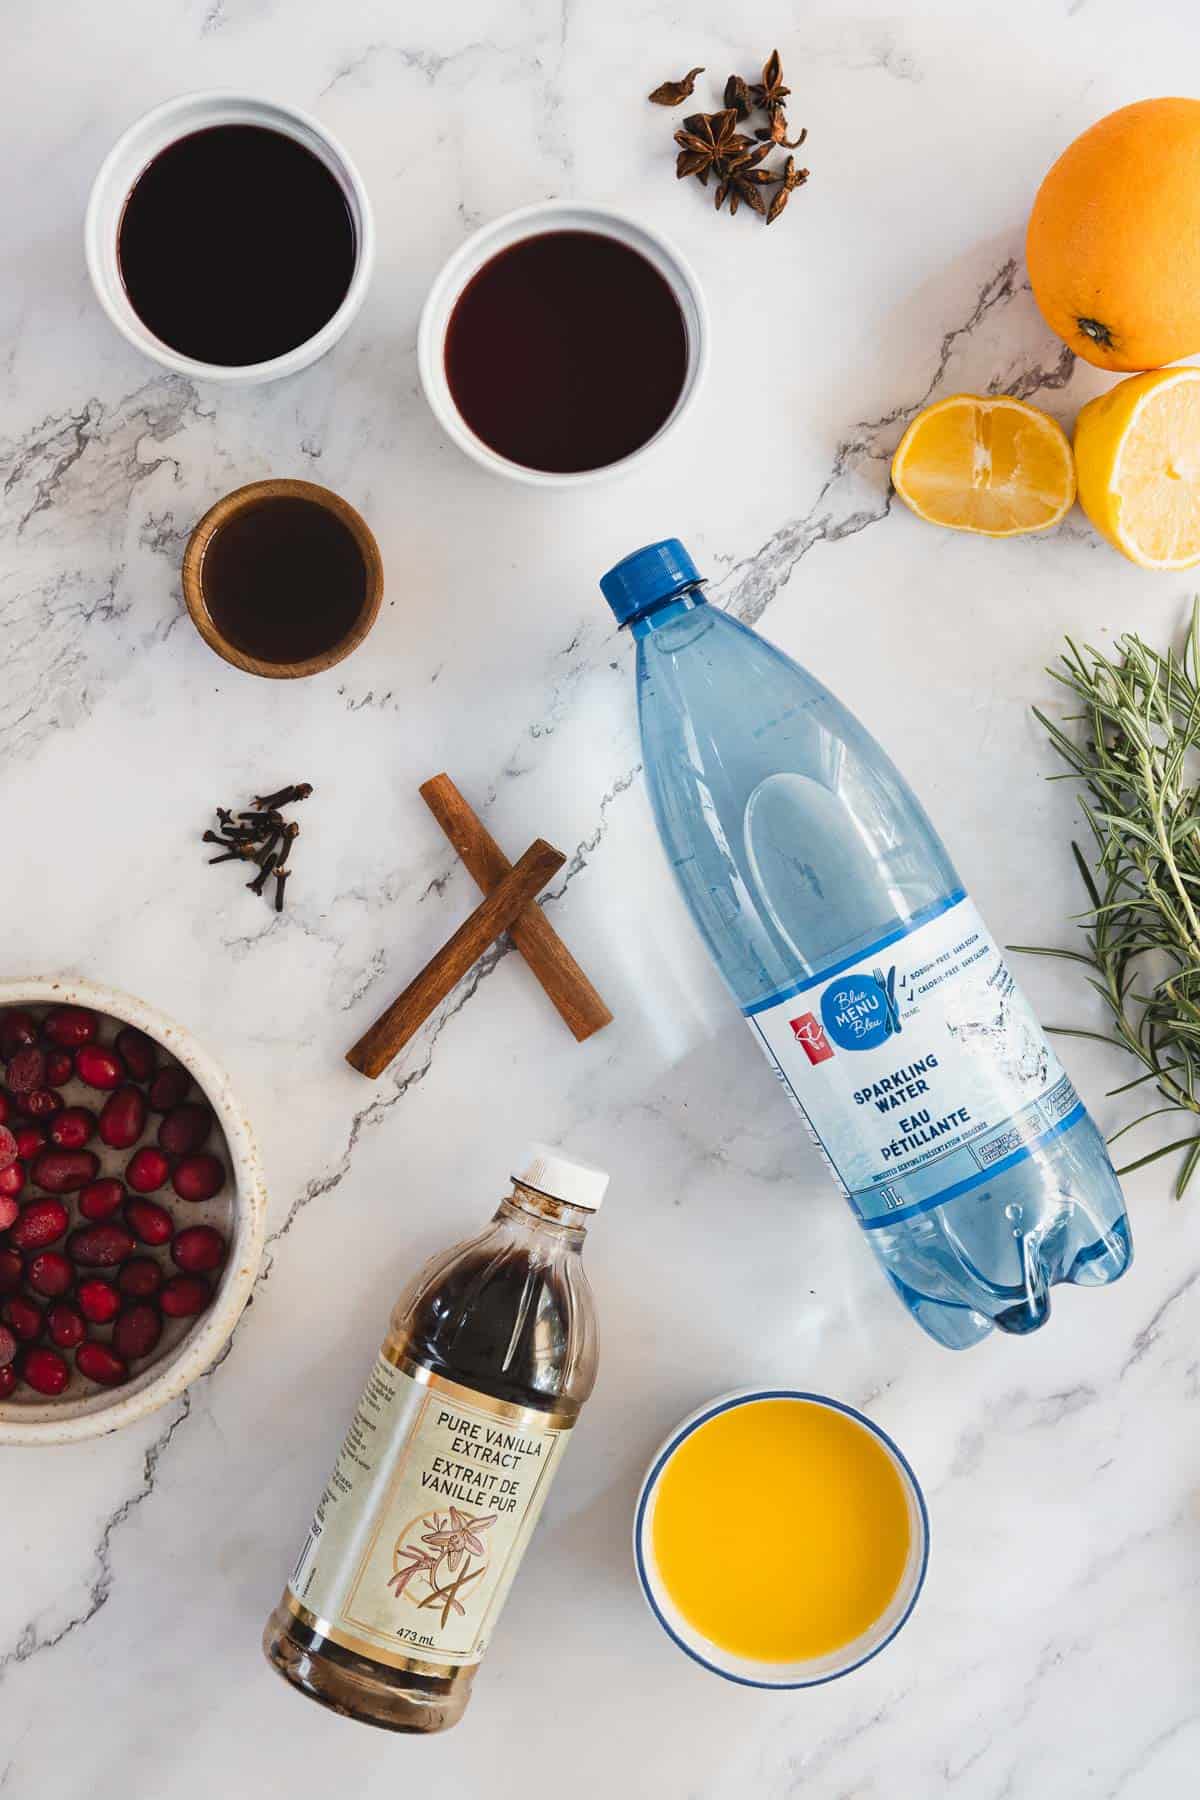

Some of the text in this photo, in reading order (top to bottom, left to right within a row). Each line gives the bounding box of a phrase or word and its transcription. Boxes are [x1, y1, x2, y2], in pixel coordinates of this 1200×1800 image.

[833, 989, 867, 1009] Blue
[835, 995, 879, 1027] MENU
[848, 1018, 881, 1038] Bleu
[853, 1054, 938, 1105] SPARKLING
[875, 1079, 930, 1113] WATER
[880, 1107, 971, 1160] PÉTILLANTE
[898, 1109, 931, 1133] EAU
[880, 1187, 904, 1209] 1L
[437, 1412, 542, 1456] PURE VANILLA
[451, 1438, 522, 1470] EXTRACT
[421, 1472, 517, 1512] VANILLE PUR
[432, 1457, 520, 1495] EXTRAIT DE
[396, 1627, 434, 1647] 473 mL
